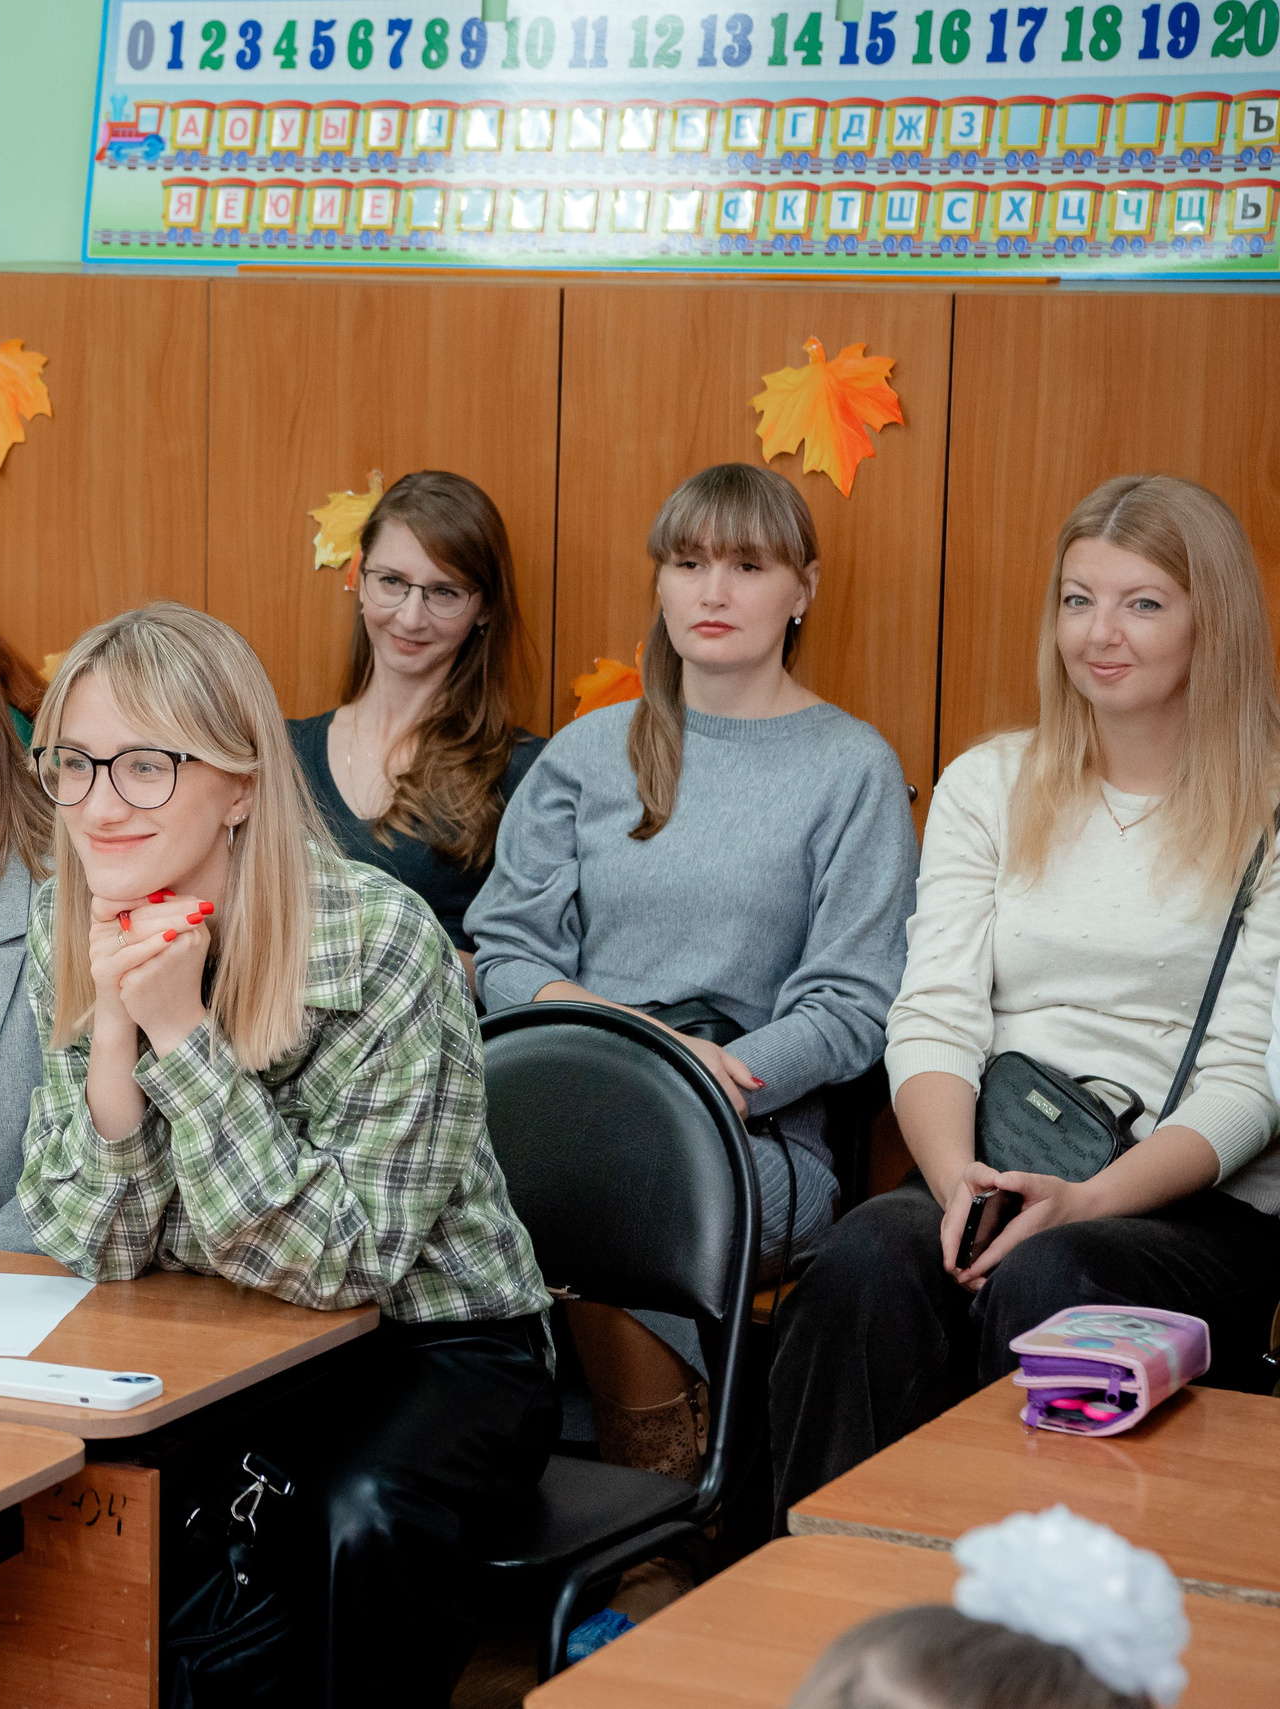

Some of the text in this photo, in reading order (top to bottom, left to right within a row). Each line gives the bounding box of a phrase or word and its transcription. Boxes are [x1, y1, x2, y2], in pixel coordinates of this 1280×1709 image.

[127, 0, 1280, 70] 0 1 2 3 4 5 6 7 8 9 10 11 12 13 14 15 16 17 18 19 20
[181, 115, 199, 137] А
[229, 117, 248, 141] О
[280, 118, 296, 142] У
[323, 116, 346, 140] Ы
[378, 118, 393, 141] Э
[681, 115, 705, 139] Б
[791, 113, 807, 138] Г
[841, 114, 865, 142] Д
[895, 114, 923, 140] Ж
[1247, 107, 1274, 133] Ъ
[174, 193, 193, 216] Я
[223, 192, 238, 219] Ё
[268, 194, 290, 217] Ю
[320, 195, 336, 218] И
[369, 195, 384, 218] Е
[781, 196, 798, 222] К
[837, 197, 855, 222] Т
[887, 196, 915, 222] Ш
[947, 197, 968, 223] С
[1005, 196, 1026, 222] Х
[1061, 197, 1085, 225] Ц
[1122, 198, 1142, 225] Ч
[1176, 196, 1205, 226] Щ
[1241, 193, 1262, 220] Ь
[1030, 1094, 1054, 1118] NAUTICA
